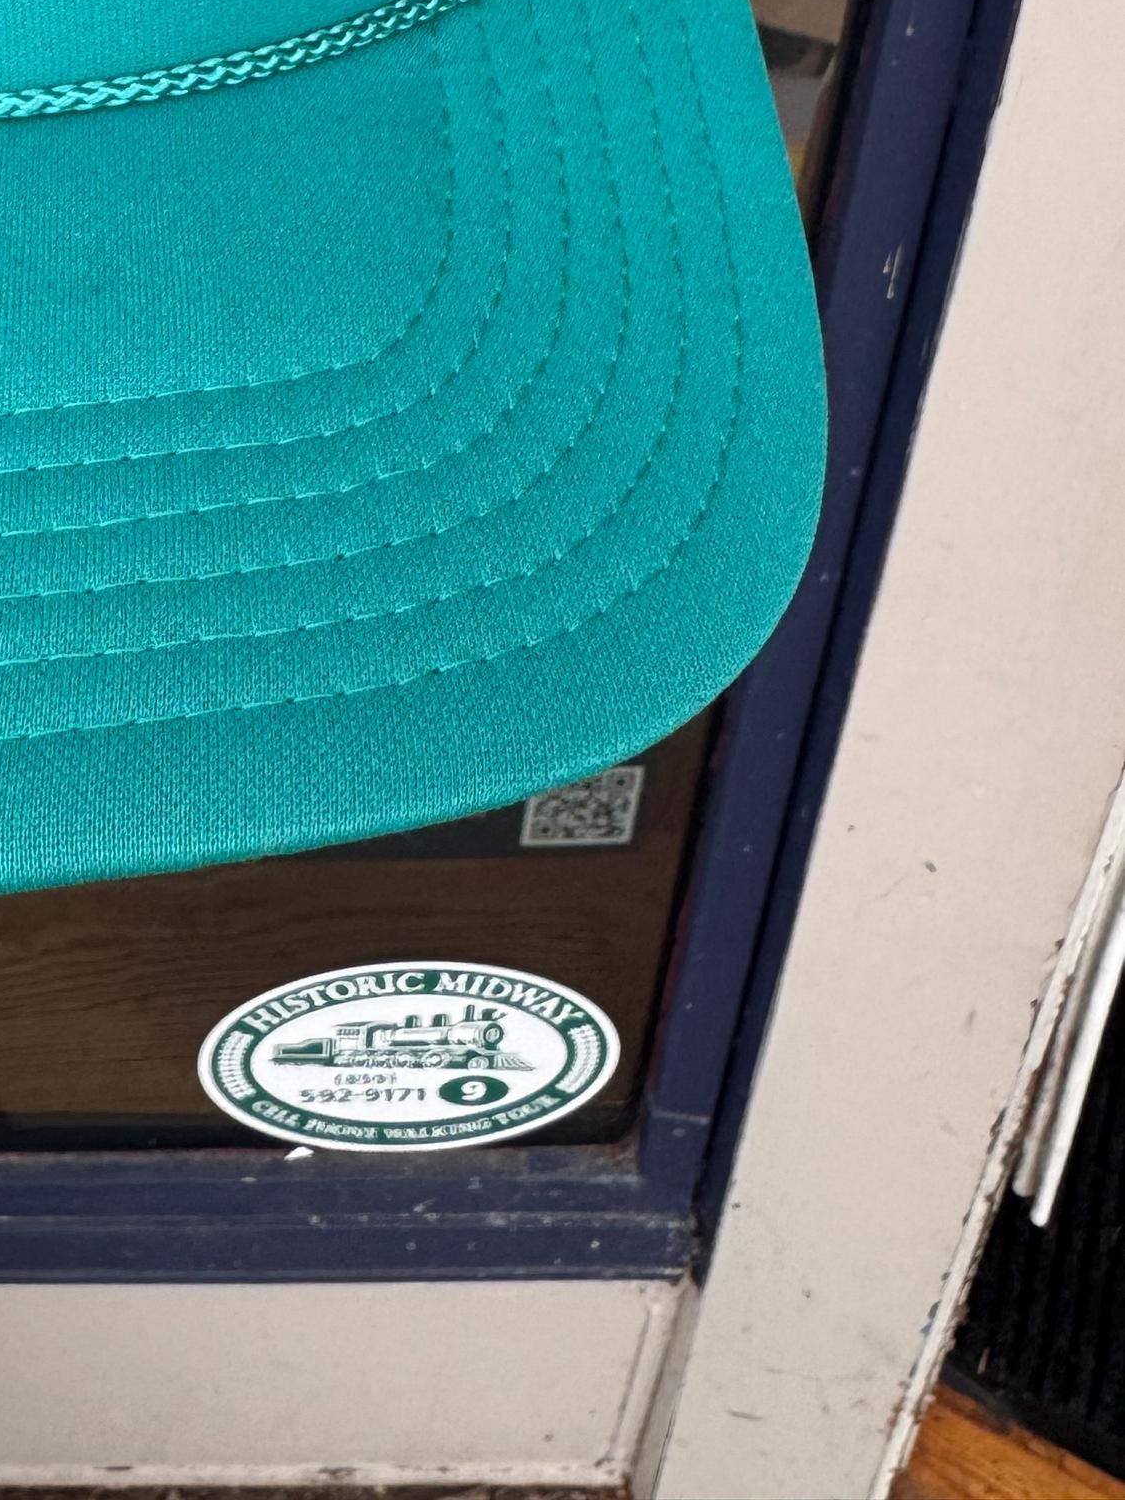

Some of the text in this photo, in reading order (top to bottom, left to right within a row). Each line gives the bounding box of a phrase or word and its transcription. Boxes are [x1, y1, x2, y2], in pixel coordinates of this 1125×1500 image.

[241, 972, 585, 1033] HISTORIC MIDWAY
[299, 1087, 427, 1102] 592-9171
[460, 1081, 487, 1100] 9
[491, 1094, 562, 1125] TOUR
